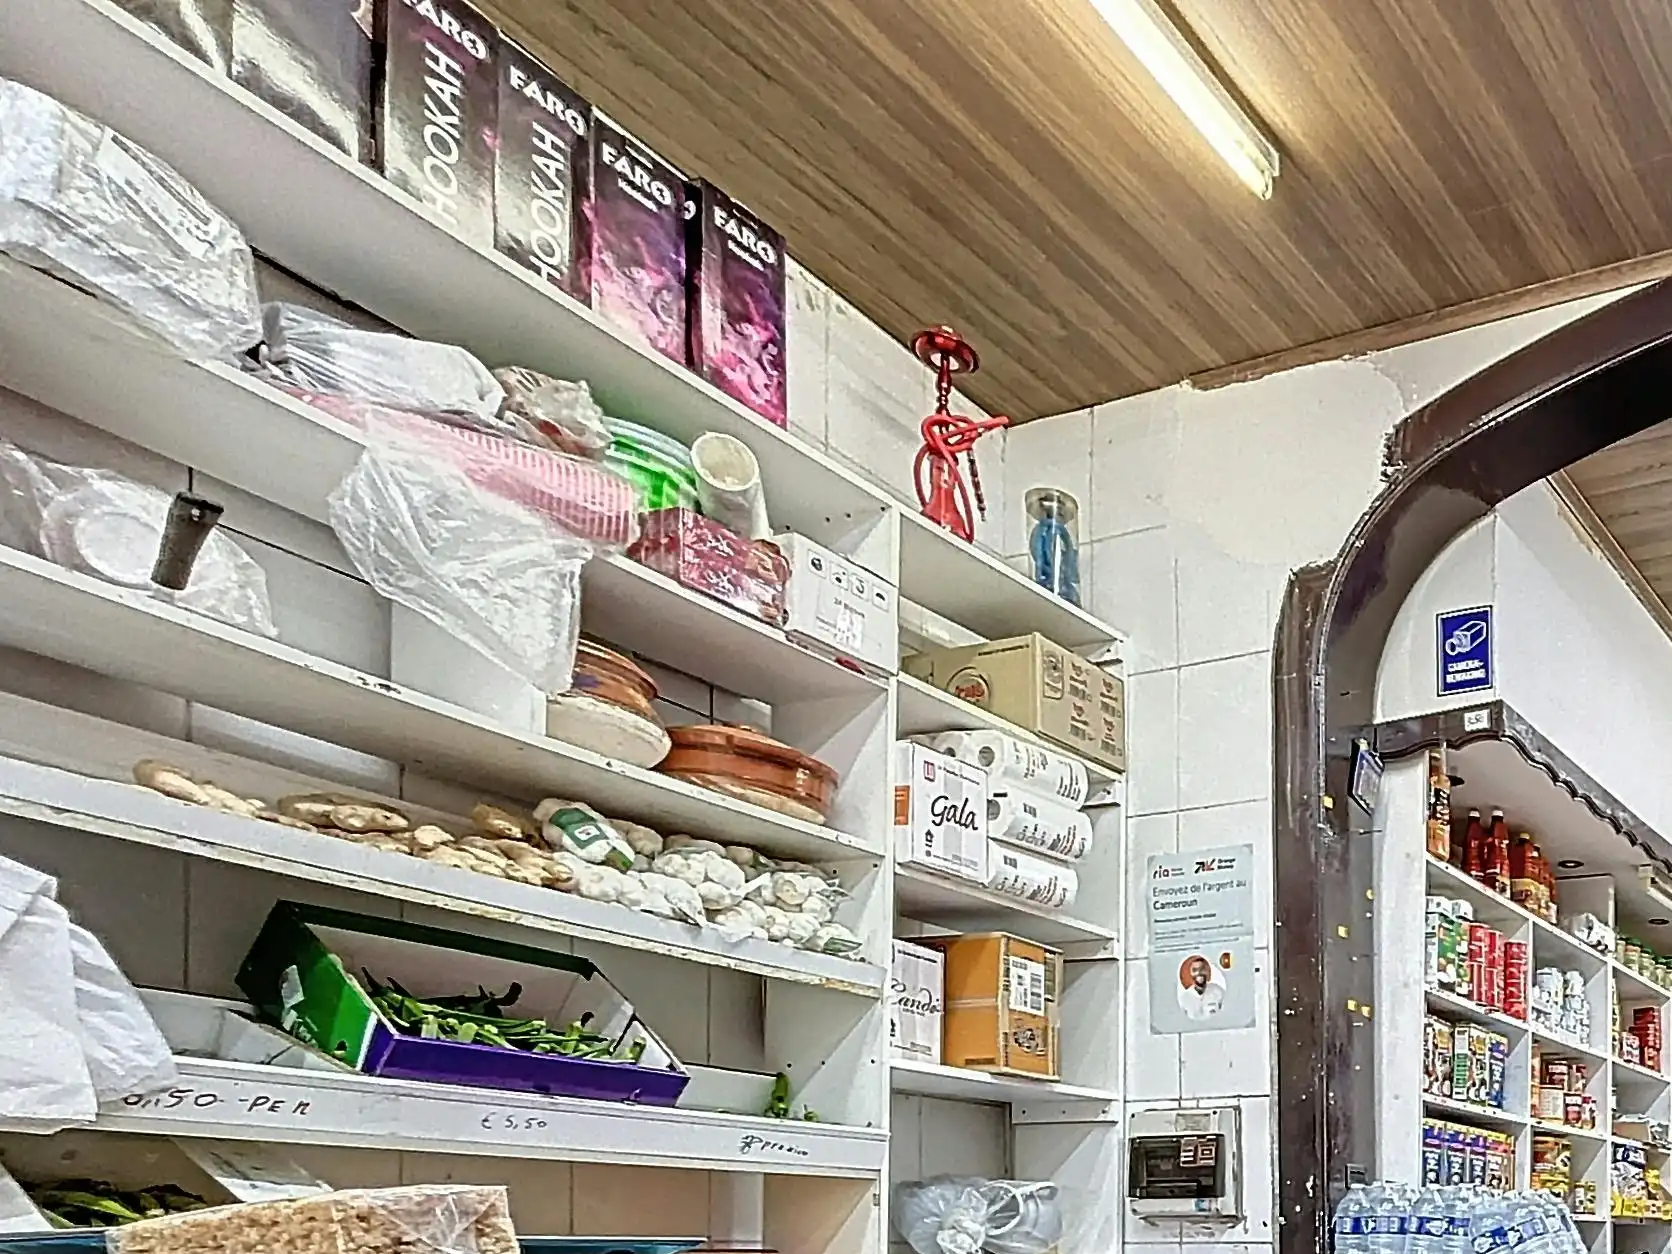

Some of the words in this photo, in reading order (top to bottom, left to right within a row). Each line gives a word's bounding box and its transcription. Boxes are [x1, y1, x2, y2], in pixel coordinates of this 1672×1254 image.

[405, 0, 490, 61] ARO
[509, 64, 588, 136] FARO
[421, 42, 470, 225] HOOKAH
[527, 121, 570, 284] HOOKAH
[602, 140, 672, 207] FARO
[714, 204, 777, 266] FARO
[931, 795, 979, 832] Gala
[1152, 884, 1189, 899] Envoyez
[1190, 883, 1201, 894] de
[1236, 879, 1247, 888] au
[1153, 898, 1198, 911] Cameroun
